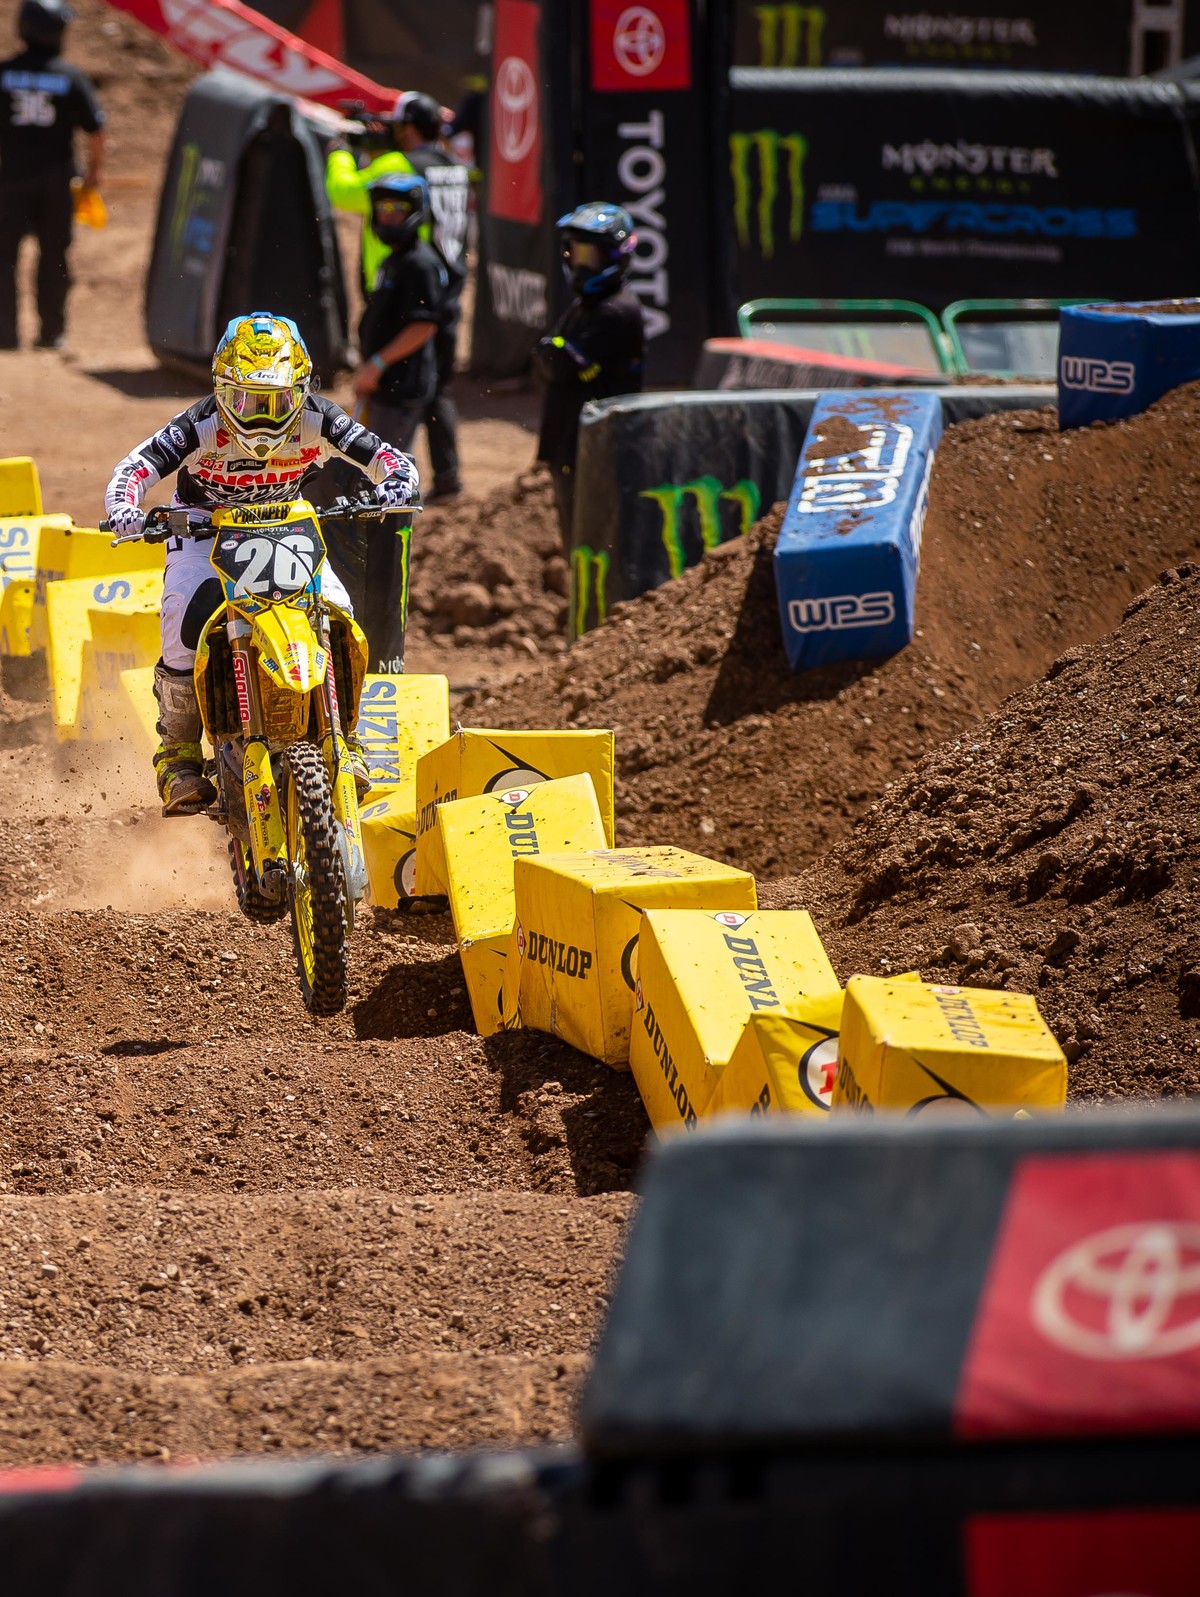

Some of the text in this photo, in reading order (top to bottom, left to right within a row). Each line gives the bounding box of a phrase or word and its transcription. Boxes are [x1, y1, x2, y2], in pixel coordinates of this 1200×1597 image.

[882, 139, 1058, 178] MONSTER
[1061, 355, 1135, 394] WPS
[234, 535, 315, 598] 26
[789, 592, 895, 633] WPS
[234, 656, 251, 723] SHOWA
[359, 681, 400, 784] SUZUKI
[527, 930, 592, 980] DUNLOP
[935, 995, 989, 1048] DUNLOP
